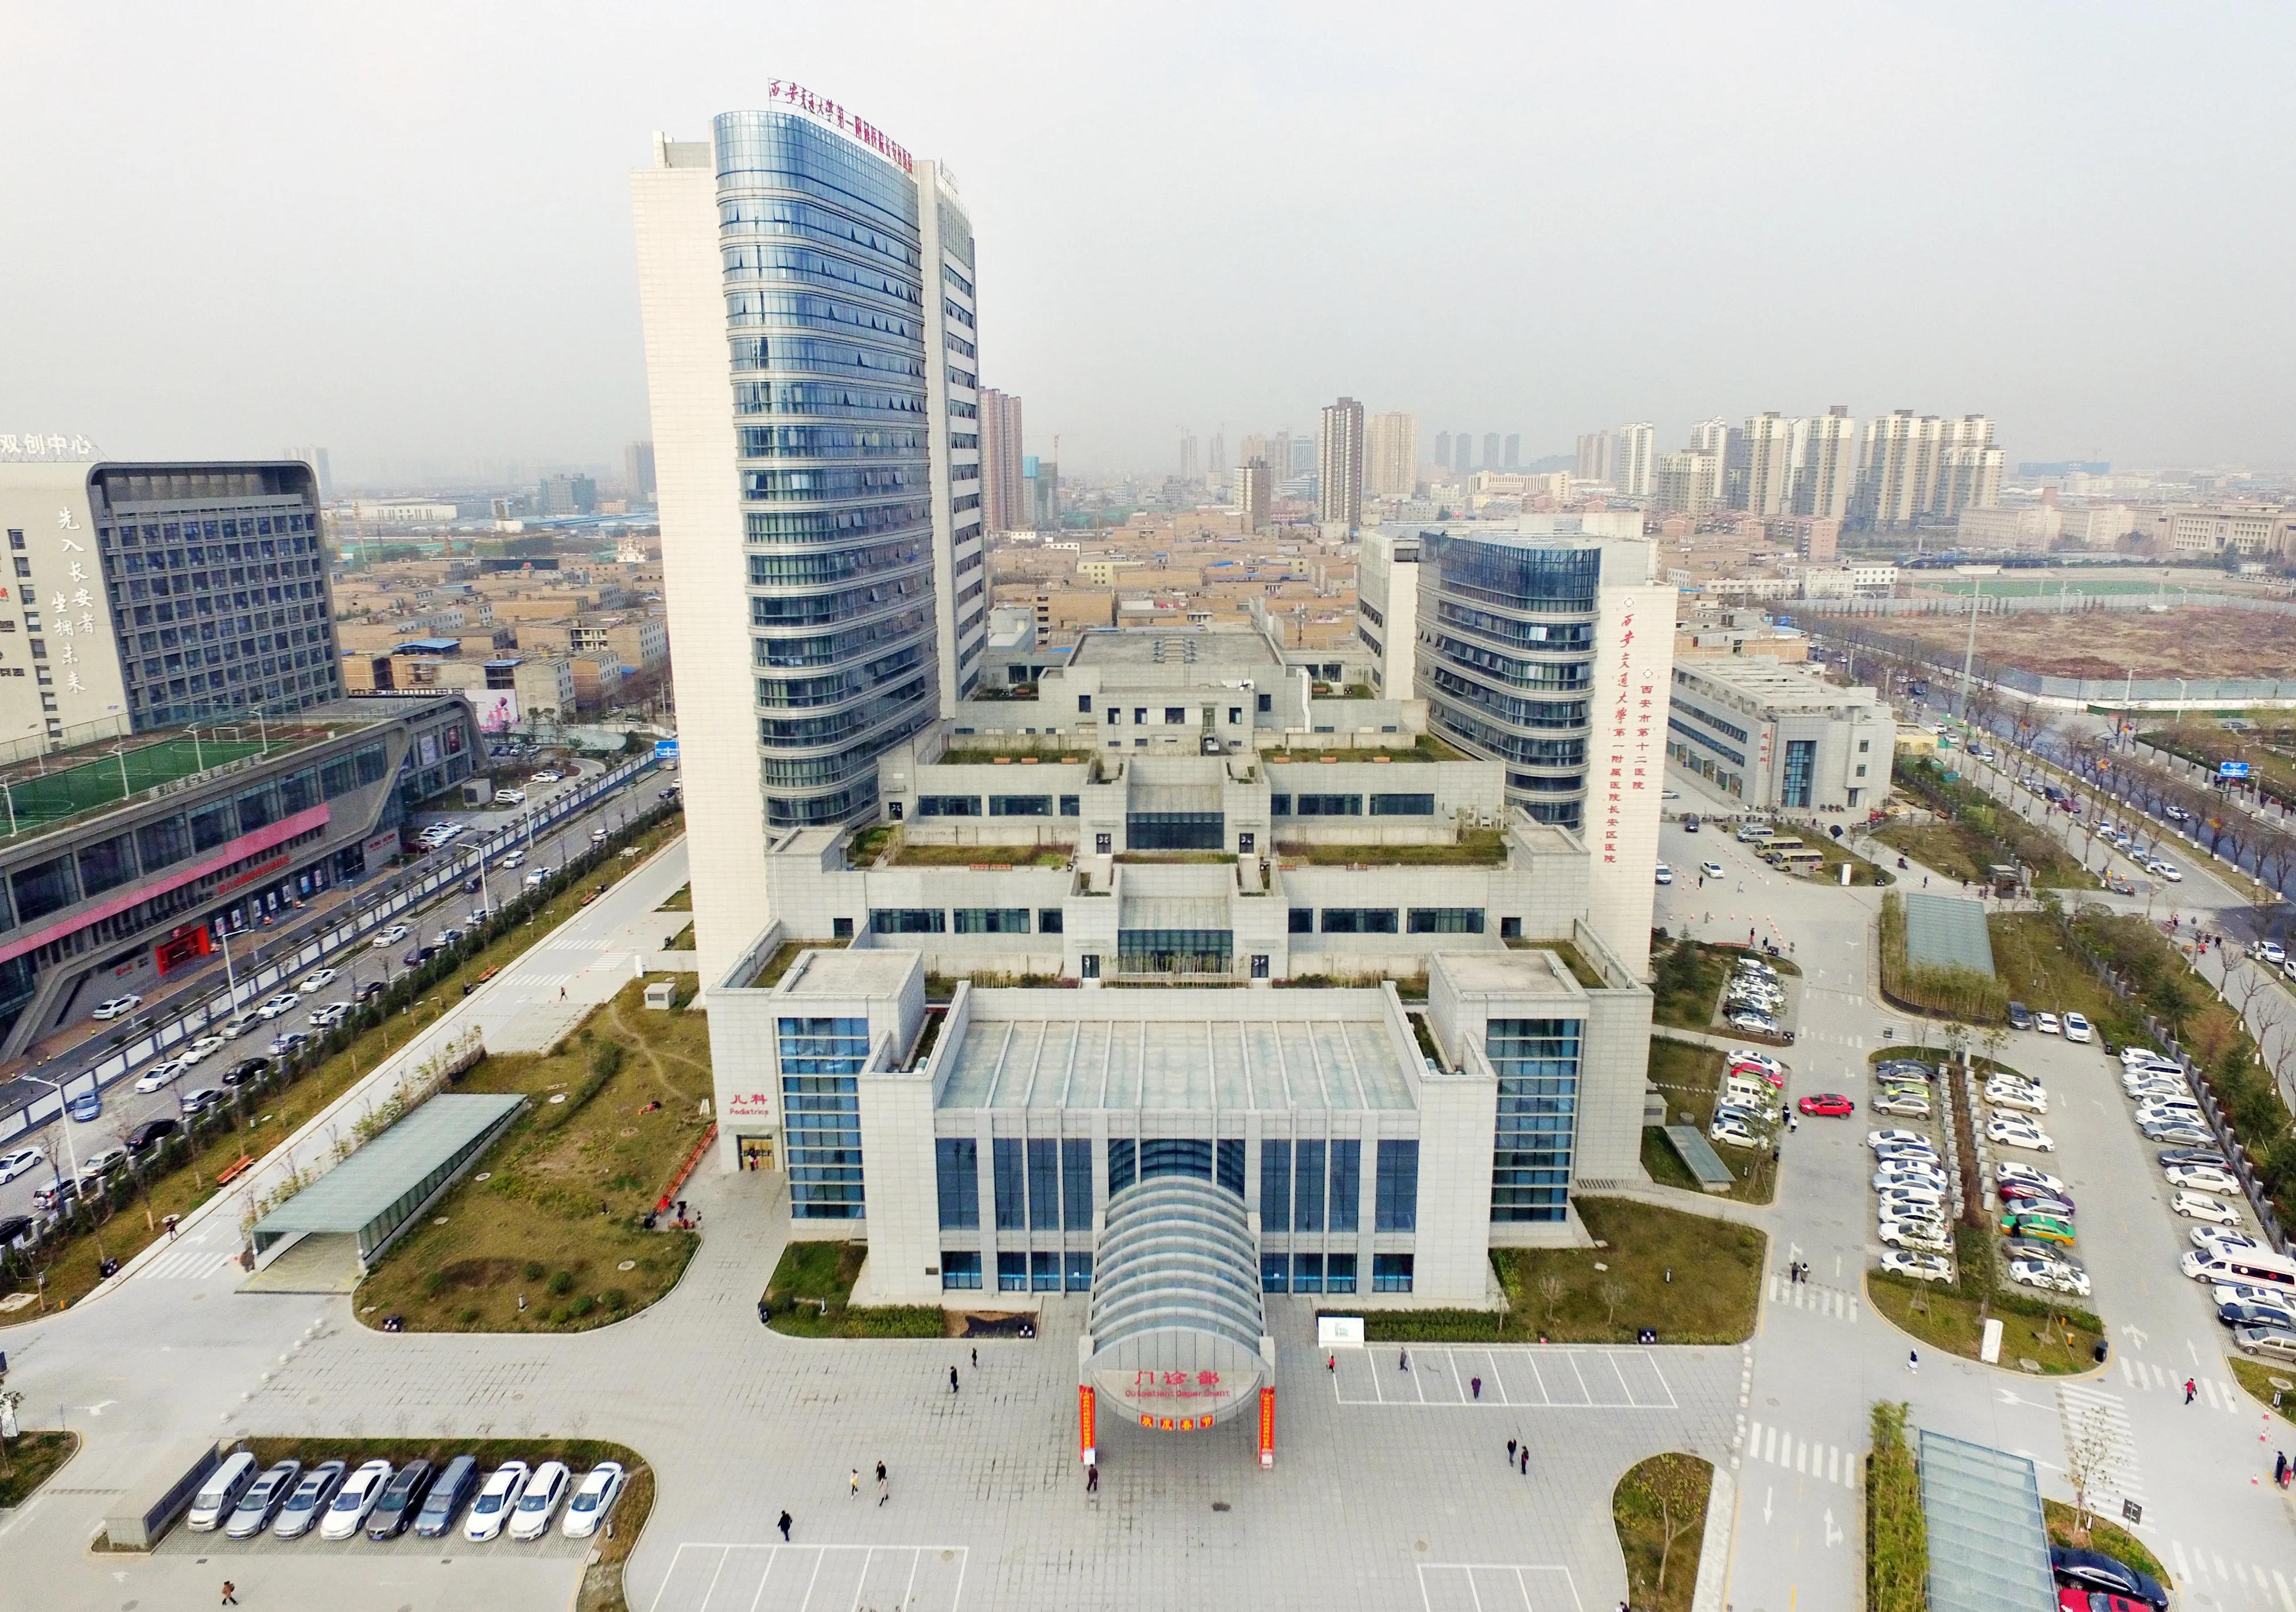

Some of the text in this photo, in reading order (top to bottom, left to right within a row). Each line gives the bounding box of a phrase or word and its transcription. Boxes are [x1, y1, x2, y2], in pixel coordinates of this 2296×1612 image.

[0, 433, 92, 455] 双创中心
[1632, 686, 1654, 789] 西安市第十二医院
[730, 1094, 767, 1105] 儿科
[1135, 1370, 1220, 1385] 门诊部
[1142, 1415, 1212, 1431] 欢度春节
